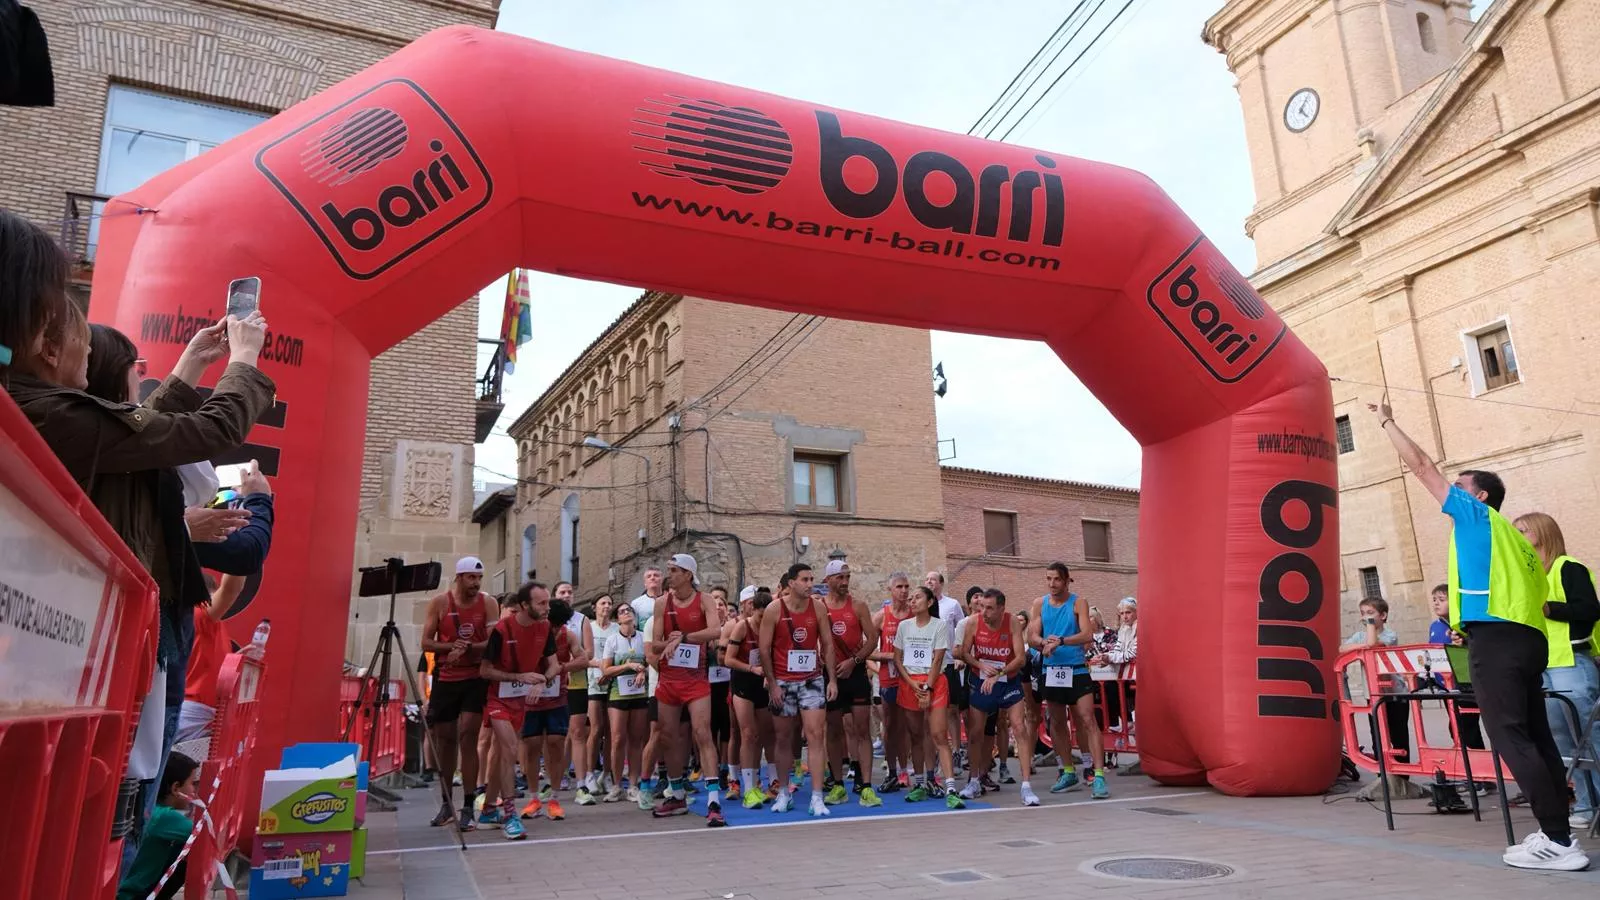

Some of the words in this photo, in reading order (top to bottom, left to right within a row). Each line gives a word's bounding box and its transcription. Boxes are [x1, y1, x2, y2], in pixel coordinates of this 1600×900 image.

[321, 138, 470, 251] barri
[815, 109, 1065, 248] barri
[631, 191, 1061, 271] www.barri-ball.com
[1169, 264, 1258, 365] barri
[1256, 479, 1340, 720] barri
[679, 648, 692, 659] 70
[798, 655, 809, 664] 87
[913, 650, 925, 659] 86
[1055, 671, 1066, 680] 48
